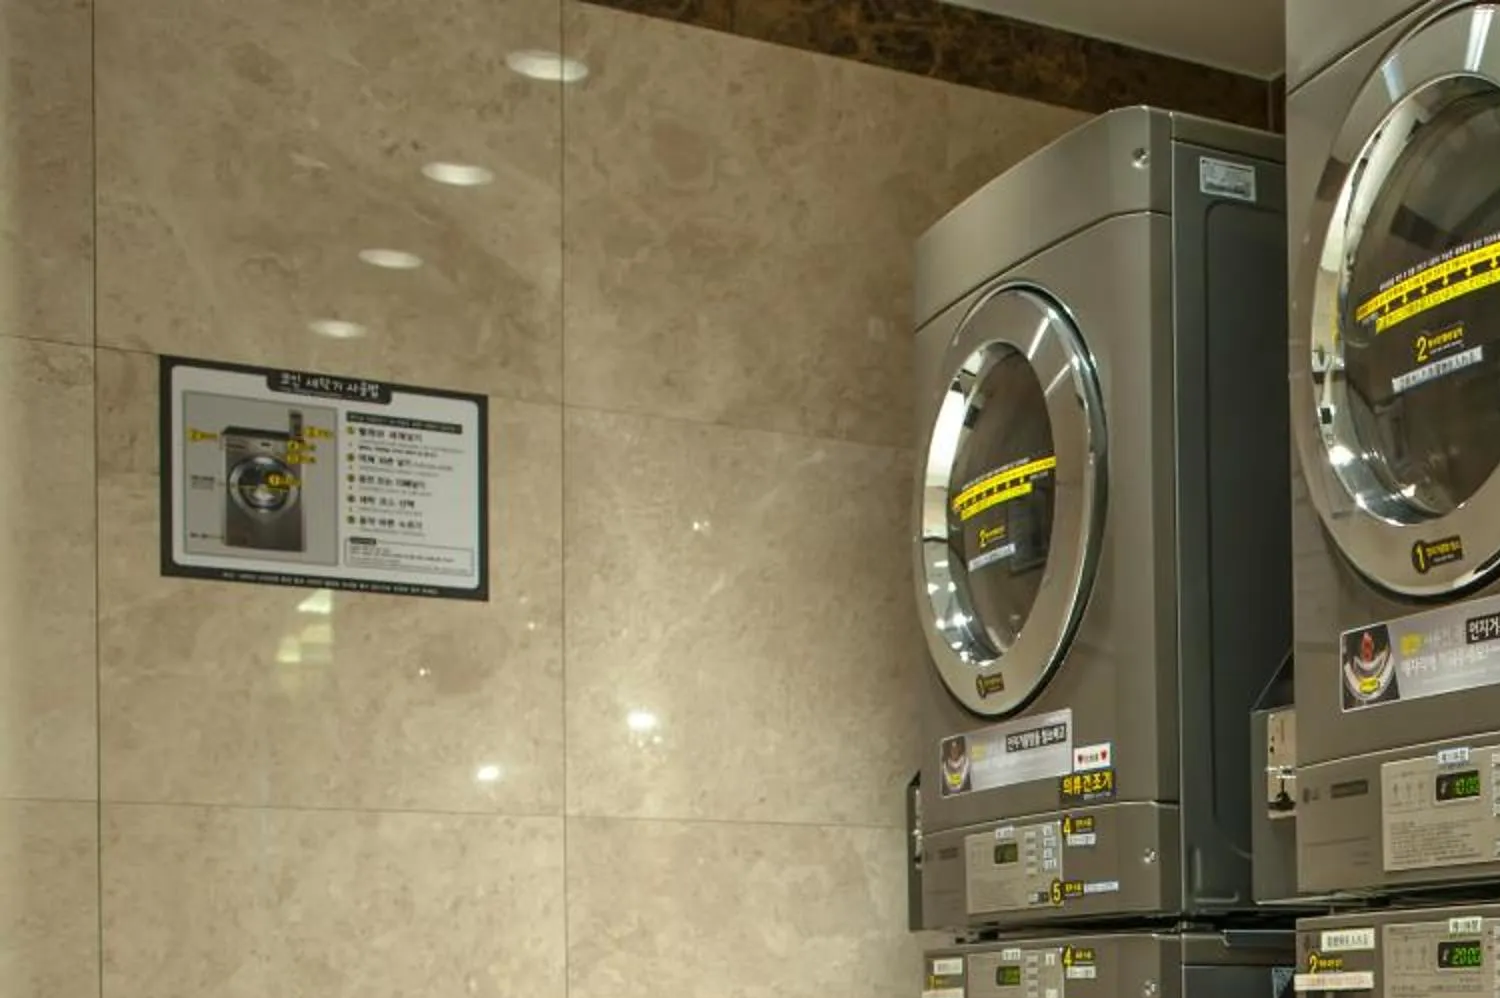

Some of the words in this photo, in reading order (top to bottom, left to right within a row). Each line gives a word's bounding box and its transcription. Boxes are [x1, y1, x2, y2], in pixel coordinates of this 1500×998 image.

[1416, 335, 1429, 362] 2
[1416, 544, 1425, 570] 1
[1063, 770, 1114, 796] 의류건조기
[1063, 817, 1072, 834] 4
[1052, 881, 1062, 900] 5
[1063, 946, 1073, 965] 4
[1309, 951, 1318, 974] 2
